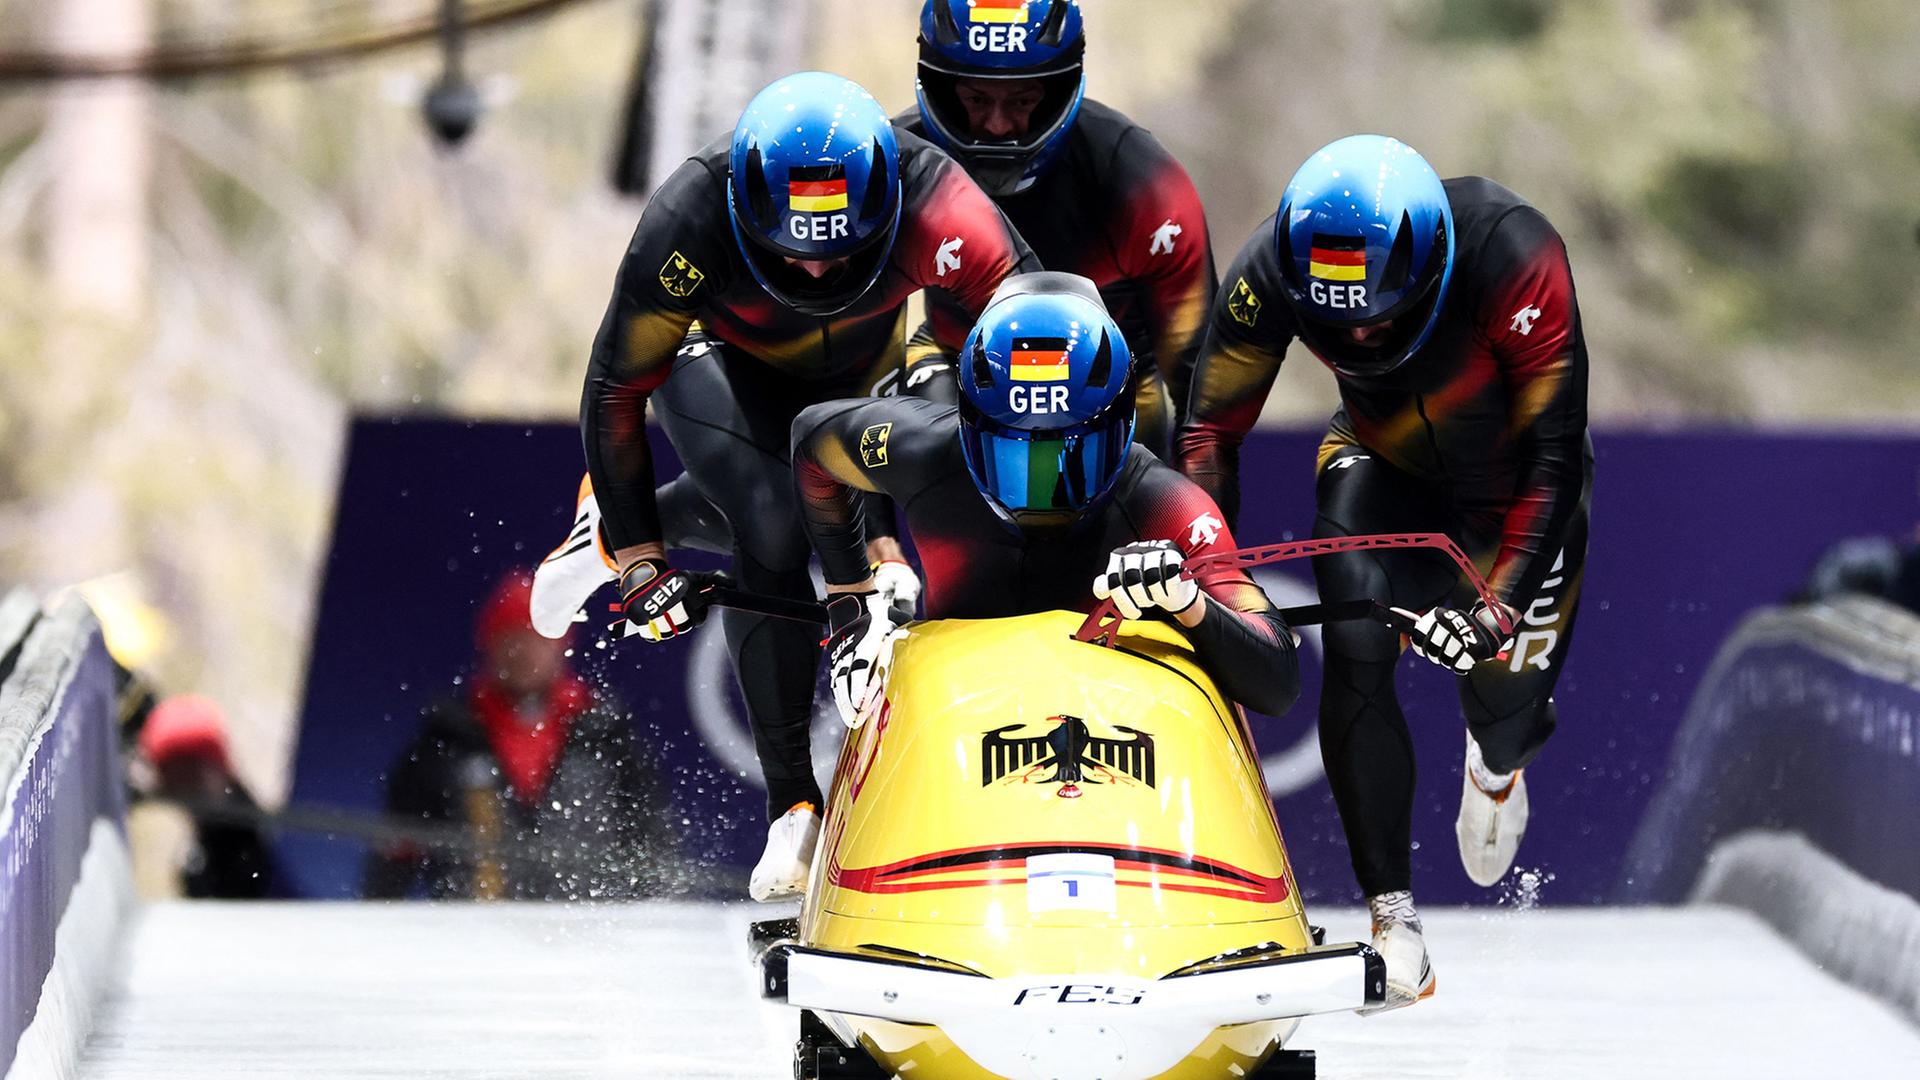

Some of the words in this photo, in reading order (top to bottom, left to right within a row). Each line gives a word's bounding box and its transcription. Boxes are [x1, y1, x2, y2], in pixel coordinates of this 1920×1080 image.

[968, 25, 1028, 53] GER
[790, 213, 849, 241] GER
[1310, 281, 1369, 309] GER
[1009, 385, 1070, 414] GER
[643, 576, 684, 616] SEIZ
[1443, 609, 1478, 649] SEIZ
[1062, 880, 1078, 897] 1
[1013, 985, 1147, 1006] FES
